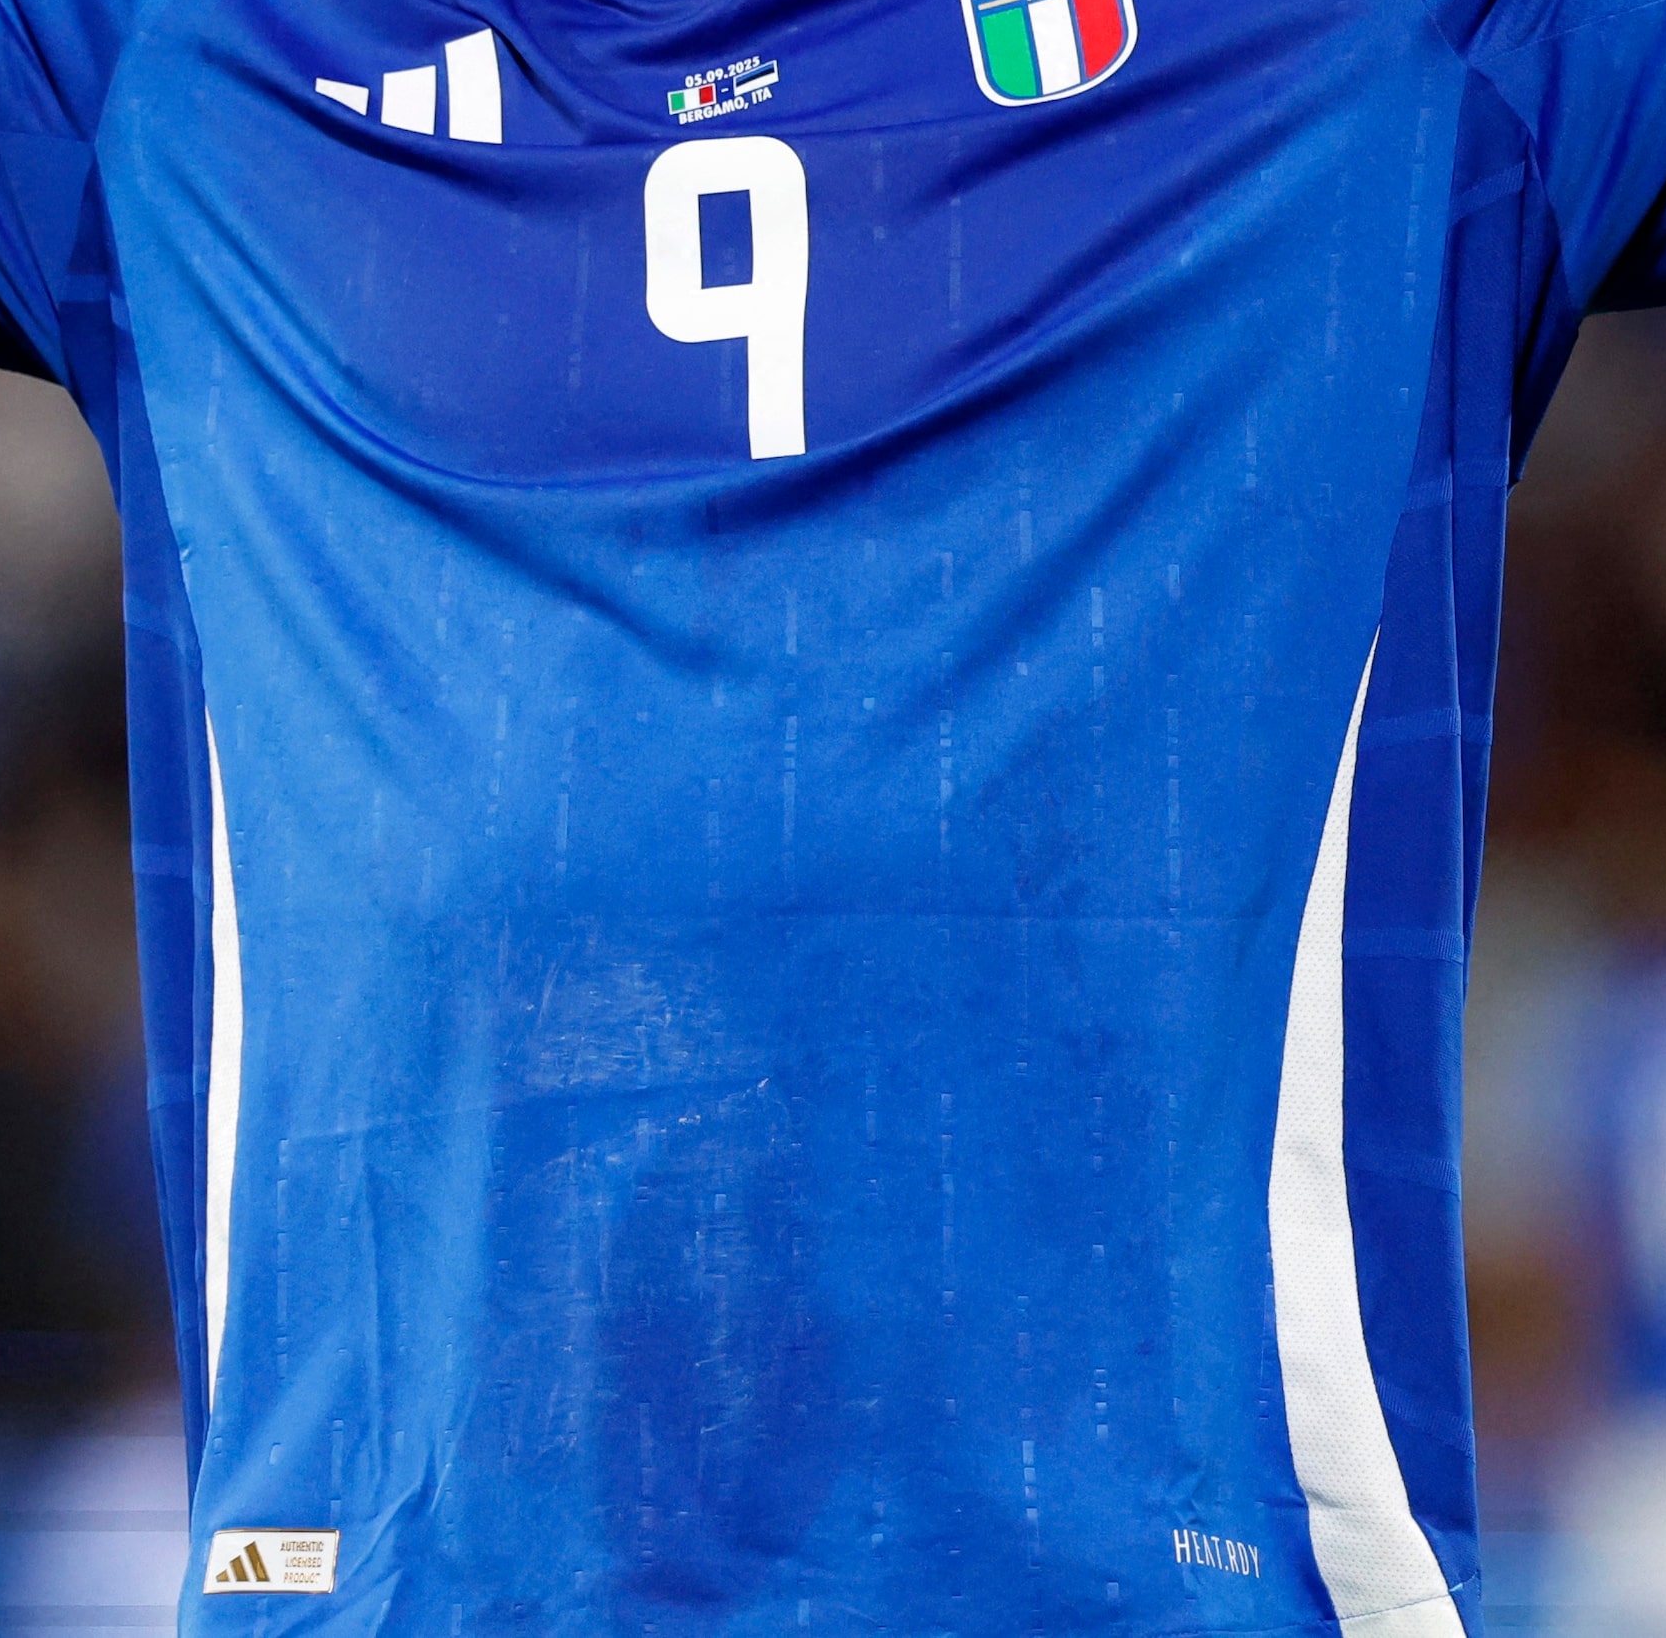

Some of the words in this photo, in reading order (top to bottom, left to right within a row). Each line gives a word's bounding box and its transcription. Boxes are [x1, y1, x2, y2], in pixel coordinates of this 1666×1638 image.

[685, 56, 760, 88] 05.09.2025
[679, 96, 749, 125] BERGAMO,
[752, 87, 773, 104] ITA
[644, 135, 809, 460] 9
[280, 1541, 324, 1552] AUTHENTIC
[1173, 1529, 1260, 1579] HEAT.RDY
